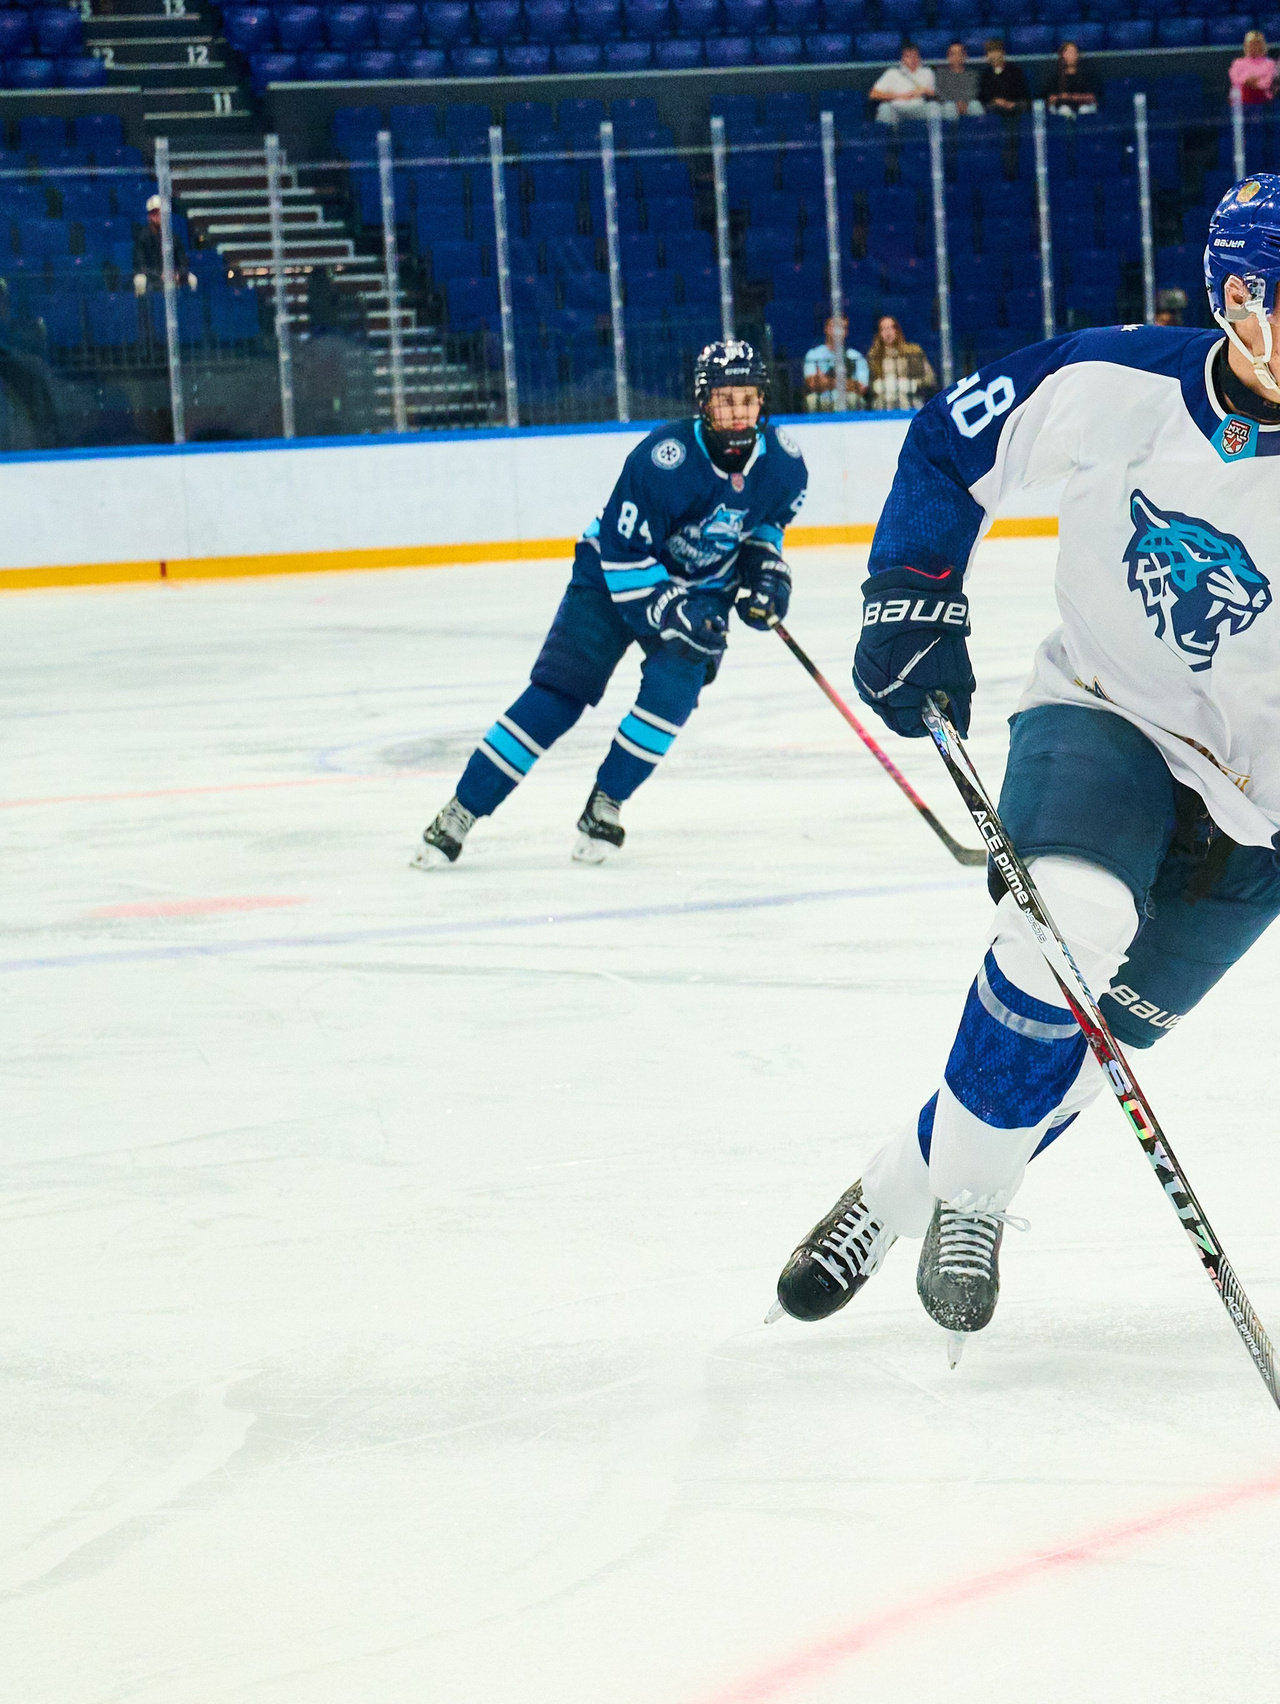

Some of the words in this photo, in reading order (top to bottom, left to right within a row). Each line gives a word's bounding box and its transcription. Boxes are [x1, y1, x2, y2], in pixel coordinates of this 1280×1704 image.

[187, 45, 209, 65] 12
[213, 93, 232, 115] 11
[863, 599, 970, 627] BAUE
[971, 810, 1003, 853] ACE
[994, 852, 1030, 905] prime
[1101, 1058, 1219, 1259] SOYUZ
[1224, 1296, 1245, 1322] ACE
[1238, 1322, 1260, 1356] prime
